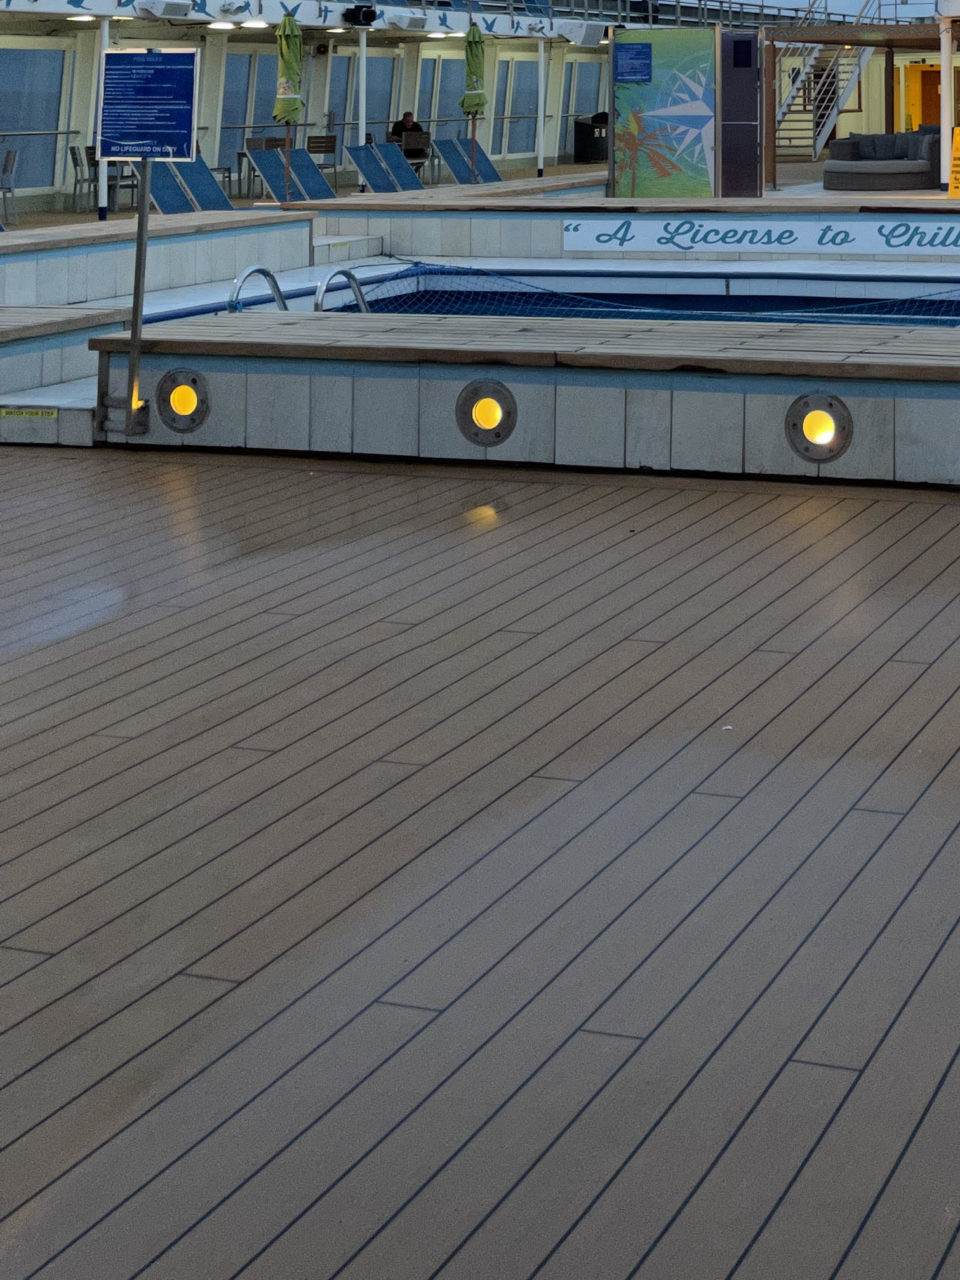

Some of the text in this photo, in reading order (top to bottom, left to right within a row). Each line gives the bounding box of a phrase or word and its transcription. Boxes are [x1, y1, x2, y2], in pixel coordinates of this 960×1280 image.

[595, 220, 636, 247] A
[656, 220, 798, 251] License
[816, 224, 856, 246] to
